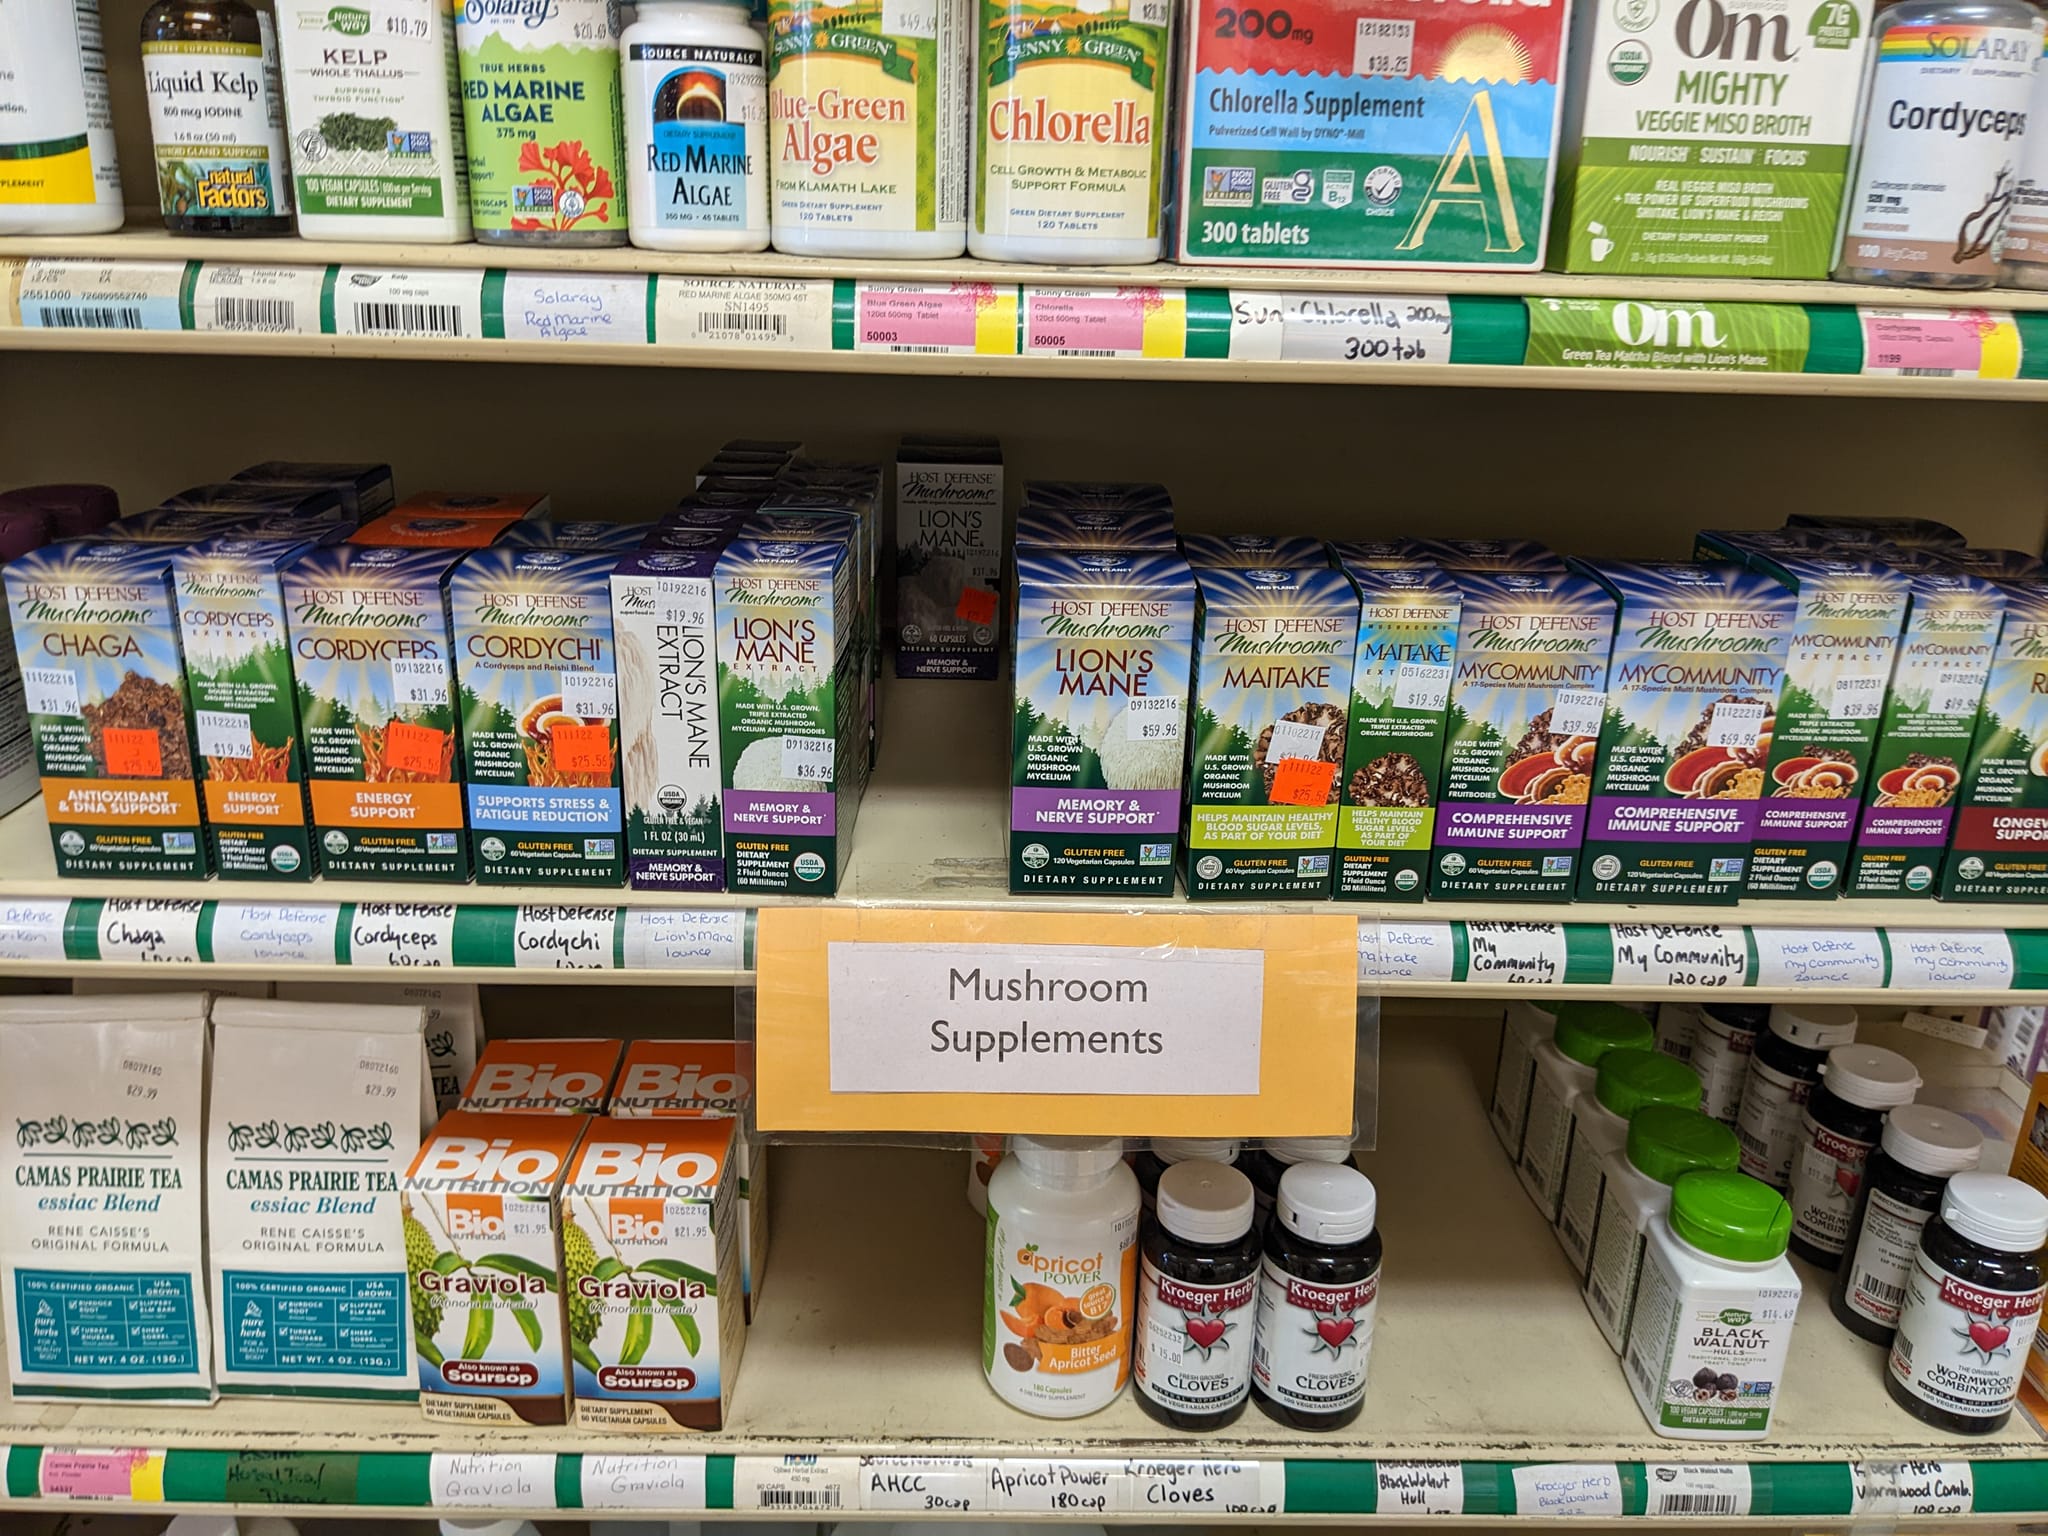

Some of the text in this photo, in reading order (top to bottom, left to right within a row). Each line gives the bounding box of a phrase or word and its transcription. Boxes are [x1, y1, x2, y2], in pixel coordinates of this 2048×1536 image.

[1826, 4, 1851, 26] 7G
[387, 16, 428, 38] $10.79
[1215, 8, 1314, 43] 200mg
[1675, 0, 1799, 62] Om
[323, 48, 388, 65] KELP
[641, 47, 756, 64] SOURCE NATURALS
[310, 68, 405, 80] WHOLE THALLUS
[148, 70, 259, 101] Liquid Kelp
[463, 80, 586, 101] RED MARINE
[1674, 70, 1789, 106] MIGHTY
[482, 103, 555, 123] ALGAE
[772, 88, 906, 122] Blue-Green
[1209, 87, 1426, 122] Chlorella Supplement
[989, 98, 1151, 145] Chlorella
[1635, 110, 1812, 137] VEGGIE MISO BROTH
[1888, 98, 2028, 140] Cordyceps
[783, 121, 877, 175] Algae
[1628, 145, 1689, 162] NOURISH
[1697, 147, 1756, 164] SUSTAIN
[647, 143, 753, 176] RED MARINE
[207, 167, 256, 185] natural
[990, 164, 1147, 179] CELL GROWTH & METABOLIC
[198, 177, 270, 209] Factors
[672, 176, 733, 206] ALGAE
[798, 180, 856, 194] KLAMATH
[860, 182, 898, 194] LAKE
[1011, 179, 1126, 193] SUPPORT FORMULA
[1202, 221, 1311, 245] 300 tablets
[534, 288, 603, 310] Solaray
[724, 301, 769, 313] SN1495
[1235, 300, 1402, 329] Sun Chlorella
[1612, 300, 1727, 347] Om
[867, 330, 898, 342] 50003
[1034, 335, 1066, 346] 50005
[1345, 335, 1426, 360] 300 tab
[1562, 348, 1593, 362] Green
[1594, 350, 1612, 362] Tea
[1613, 351, 1651, 363] Matcha
[1652, 352, 1681, 364] Blend
[1682, 353, 1706, 365] with
[919, 510, 983, 529] LION'S
[919, 530, 981, 548] MANE
[25, 584, 149, 602] HOST DEFENSE
[18, 599, 154, 625] Mushrooms
[184, 609, 274, 628] CORDYCEPS
[666, 609, 705, 625] $19.96
[1051, 601, 1169, 617] HOST DEFENSE
[733, 617, 816, 641] LION'S
[1041, 613, 1170, 639] Mushrooms
[43, 632, 144, 658] CHAGA
[468, 634, 602, 661] CORDYCHI
[735, 641, 815, 664] MANE
[1364, 642, 1451, 662] MAITAKE
[483, 662, 595, 672] Cordyceps and Reishi Blend
[1056, 648, 1154, 673] LION'S
[656, 624, 684, 721] EXTRACT
[1223, 665, 1331, 690] MAITAKE
[1059, 673, 1148, 697] MANE
[681, 624, 710, 769] LION'S MANE
[1130, 699, 1178, 712] 09132216
[575, 702, 614, 716] $31.96
[1142, 724, 1178, 737] $59.96
[1719, 732, 1757, 747] $69.96
[797, 765, 833, 780] $36.96
[69, 789, 169, 803] ANTIOXIDANT
[355, 792, 413, 806] ENERGY
[476, 795, 610, 810] SUPPORTS STRESS &
[1057, 799, 1141, 812] MEMORY &
[59, 802, 179, 815] & DNA SUPPORT
[350, 805, 417, 819] SUPPORT
[475, 808, 609, 823] FATIGUE REDUCTION
[1036, 811, 1155, 825] NERVE SUPPORT
[1452, 812, 1572, 826] COMPREHENSIVE
[1446, 826, 1569, 840] IMMUNE SUPPORT
[1064, 848, 1125, 858] GLUTEN FREE
[1023, 874, 1164, 886] DIETARY SUPPLEMENT
[106, 921, 167, 951] Chaga
[355, 924, 438, 950] Cordyceps
[518, 930, 601, 955] Cordychi
[1655, 945, 1745, 973] Community
[950, 967, 1149, 1002] Mushroom
[930, 1020, 1165, 1063] Supplements
[418, 1136, 560, 1181] Bio
[582, 1142, 719, 1187] Bio
[15, 1165, 183, 1190] CAMAS PRAIRIE TEA
[403, 1178, 551, 1195] NUTRITION
[567, 1183, 717, 1198] NUTRITION
[38, 1194, 161, 1213] essiac Blend
[31, 1238, 170, 1253] ORIGINAL FORMULA
[418, 1270, 547, 1295] Graviola
[1043, 1270, 1102, 1286] POWER
[578, 1276, 706, 1302] Graviola
[1161, 1279, 1221, 1304] Kroeger
[1944, 1279, 2011, 1310] Kroeger
[1702, 1326, 1766, 1340] BLACK
[1070, 1345, 1102, 1359] Bitter
[1693, 1337, 1770, 1350] WALNUT
[1049, 1347, 1117, 1371] Apricot Seed
[446, 1368, 533, 1386] Soursop
[1168, 1374, 1230, 1393] CLOVES
[1926, 1370, 2013, 1397] COMBINATION
[1935, 1363, 2014, 1387] WORMWOOD
[871, 1473, 927, 1493] AHCC
[991, 1466, 1108, 1496] Apricot Power
[1147, 1485, 1215, 1503] Cloves
[1401, 1491, 1426, 1505] Hull
